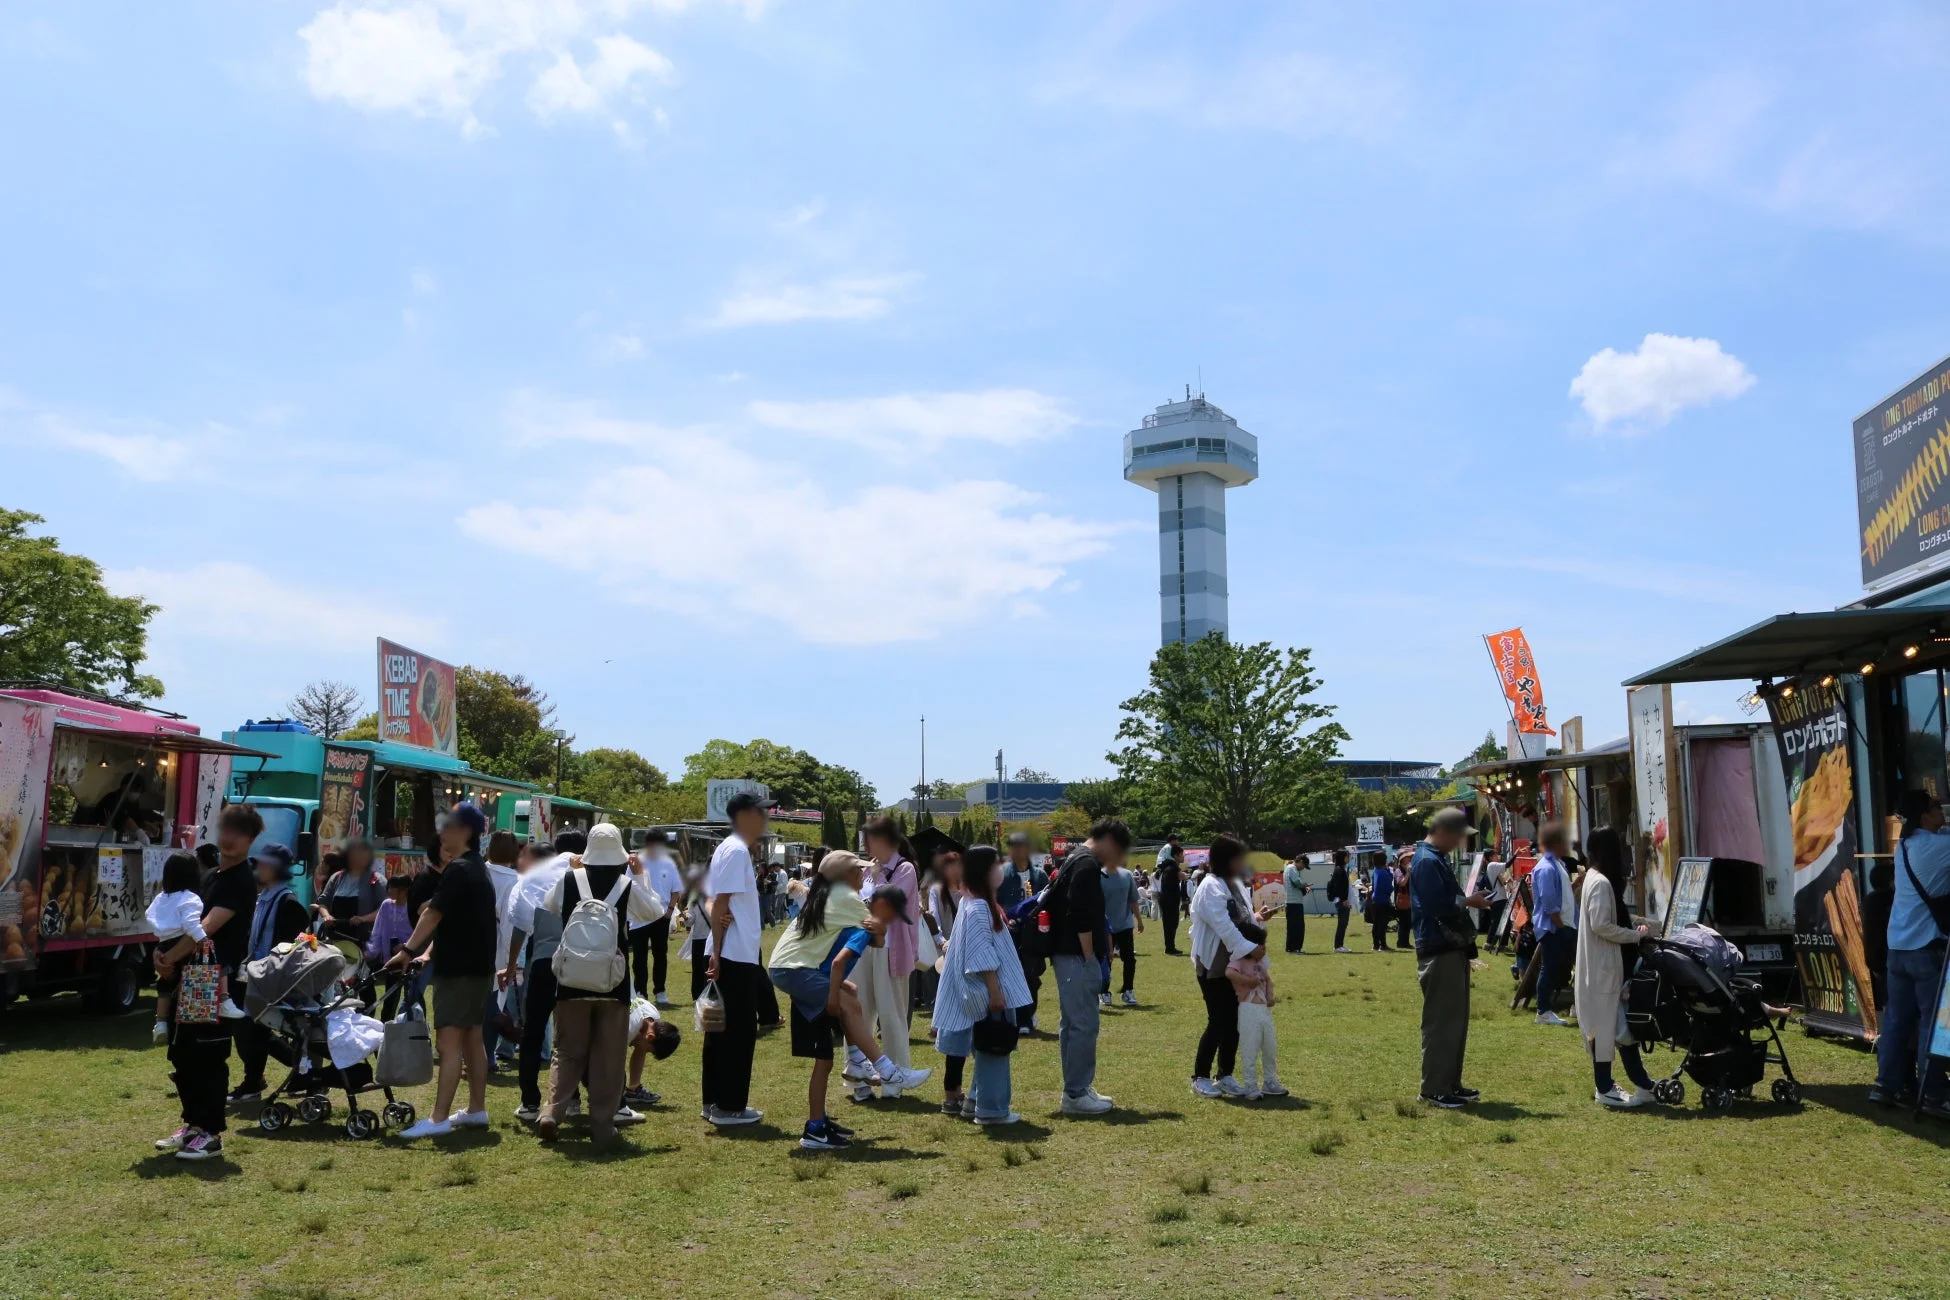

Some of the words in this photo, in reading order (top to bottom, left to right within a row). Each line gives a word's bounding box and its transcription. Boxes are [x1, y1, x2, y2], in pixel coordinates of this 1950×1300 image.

[1881, 403, 1901, 431] LONG
[1902, 378, 1940, 417] TORNADO
[1883, 405, 1939, 446] ロングトルネードポテト
[1917, 509, 1940, 537] LONG
[385, 654, 418, 684] KEBAB
[1501, 636, 1516, 685] 富士宮
[385, 688, 411, 717] TIME
[1517, 677, 1549, 731] やきそば
[1783, 712, 1847, 756] ロングポテト
[1796, 951, 1843, 991] LONG
[1808, 988, 1844, 1014] CHURROS
